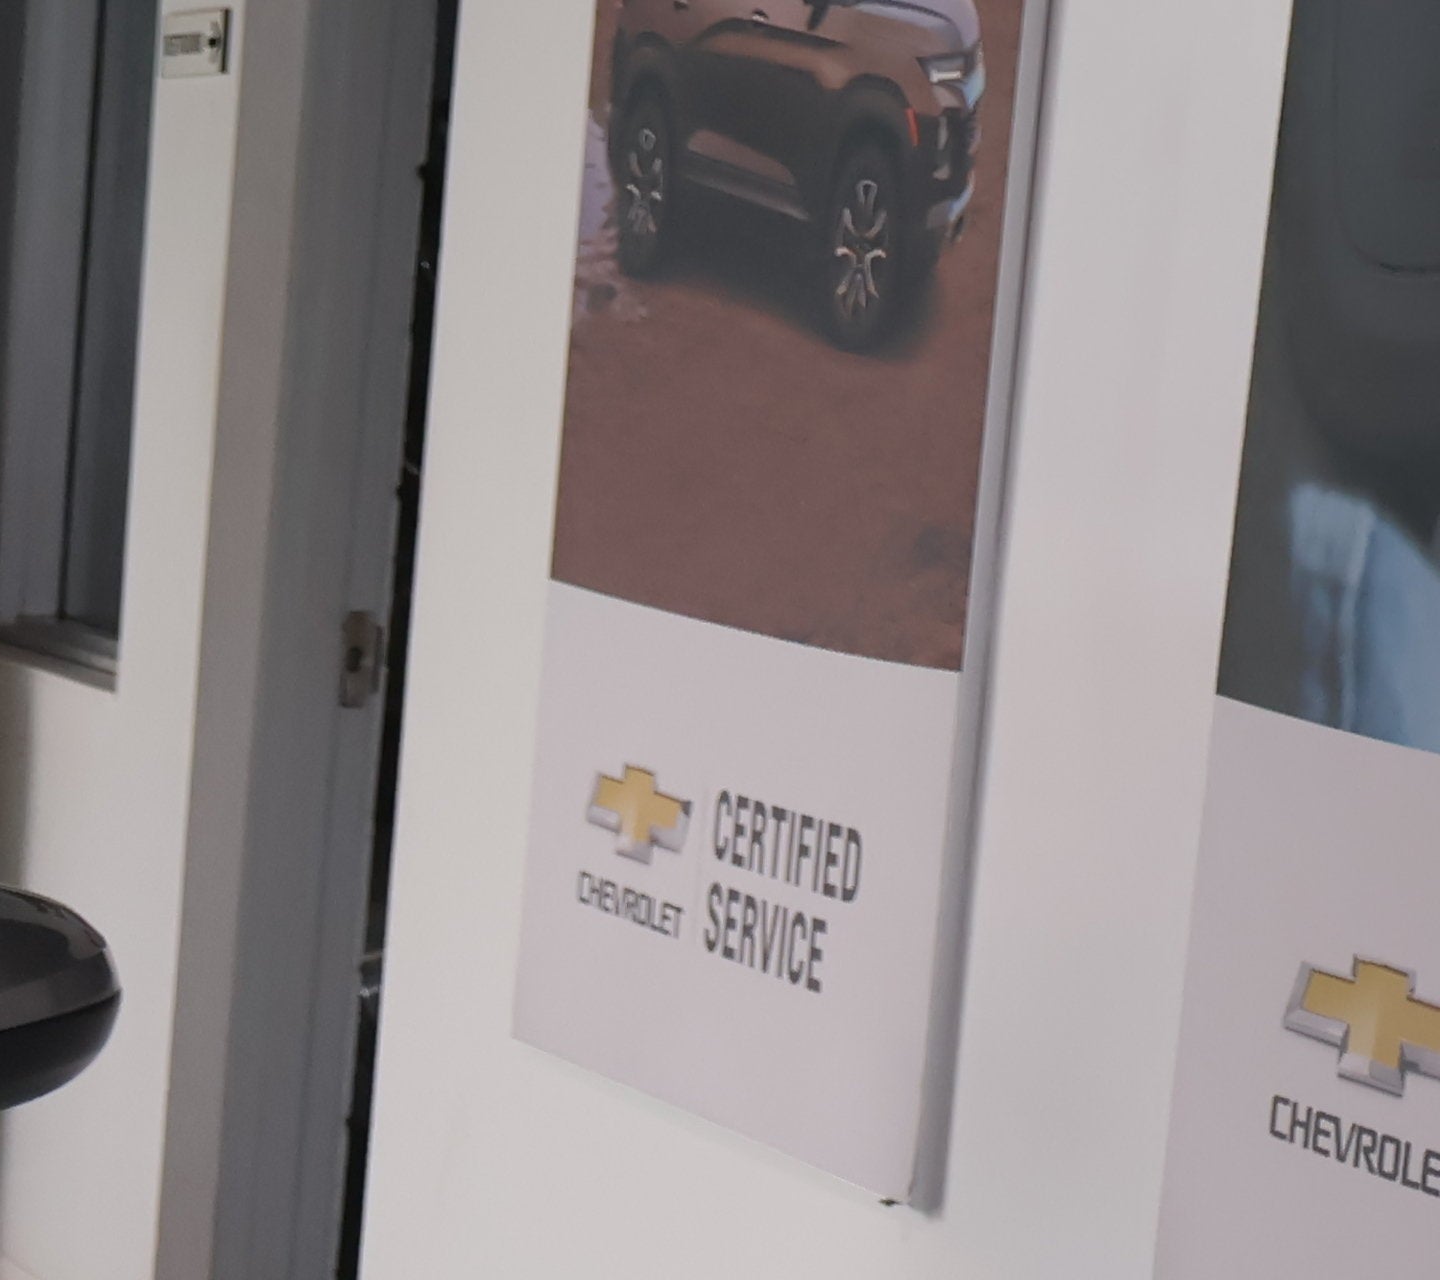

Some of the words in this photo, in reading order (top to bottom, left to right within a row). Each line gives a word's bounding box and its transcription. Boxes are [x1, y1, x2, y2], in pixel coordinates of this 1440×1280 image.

[714, 790, 863, 903] CERTIFIED
[577, 870, 685, 939] CHEVROLET
[703, 882, 829, 993] SERVICE
[1269, 1094, 1440, 1198] CHEVROLE
